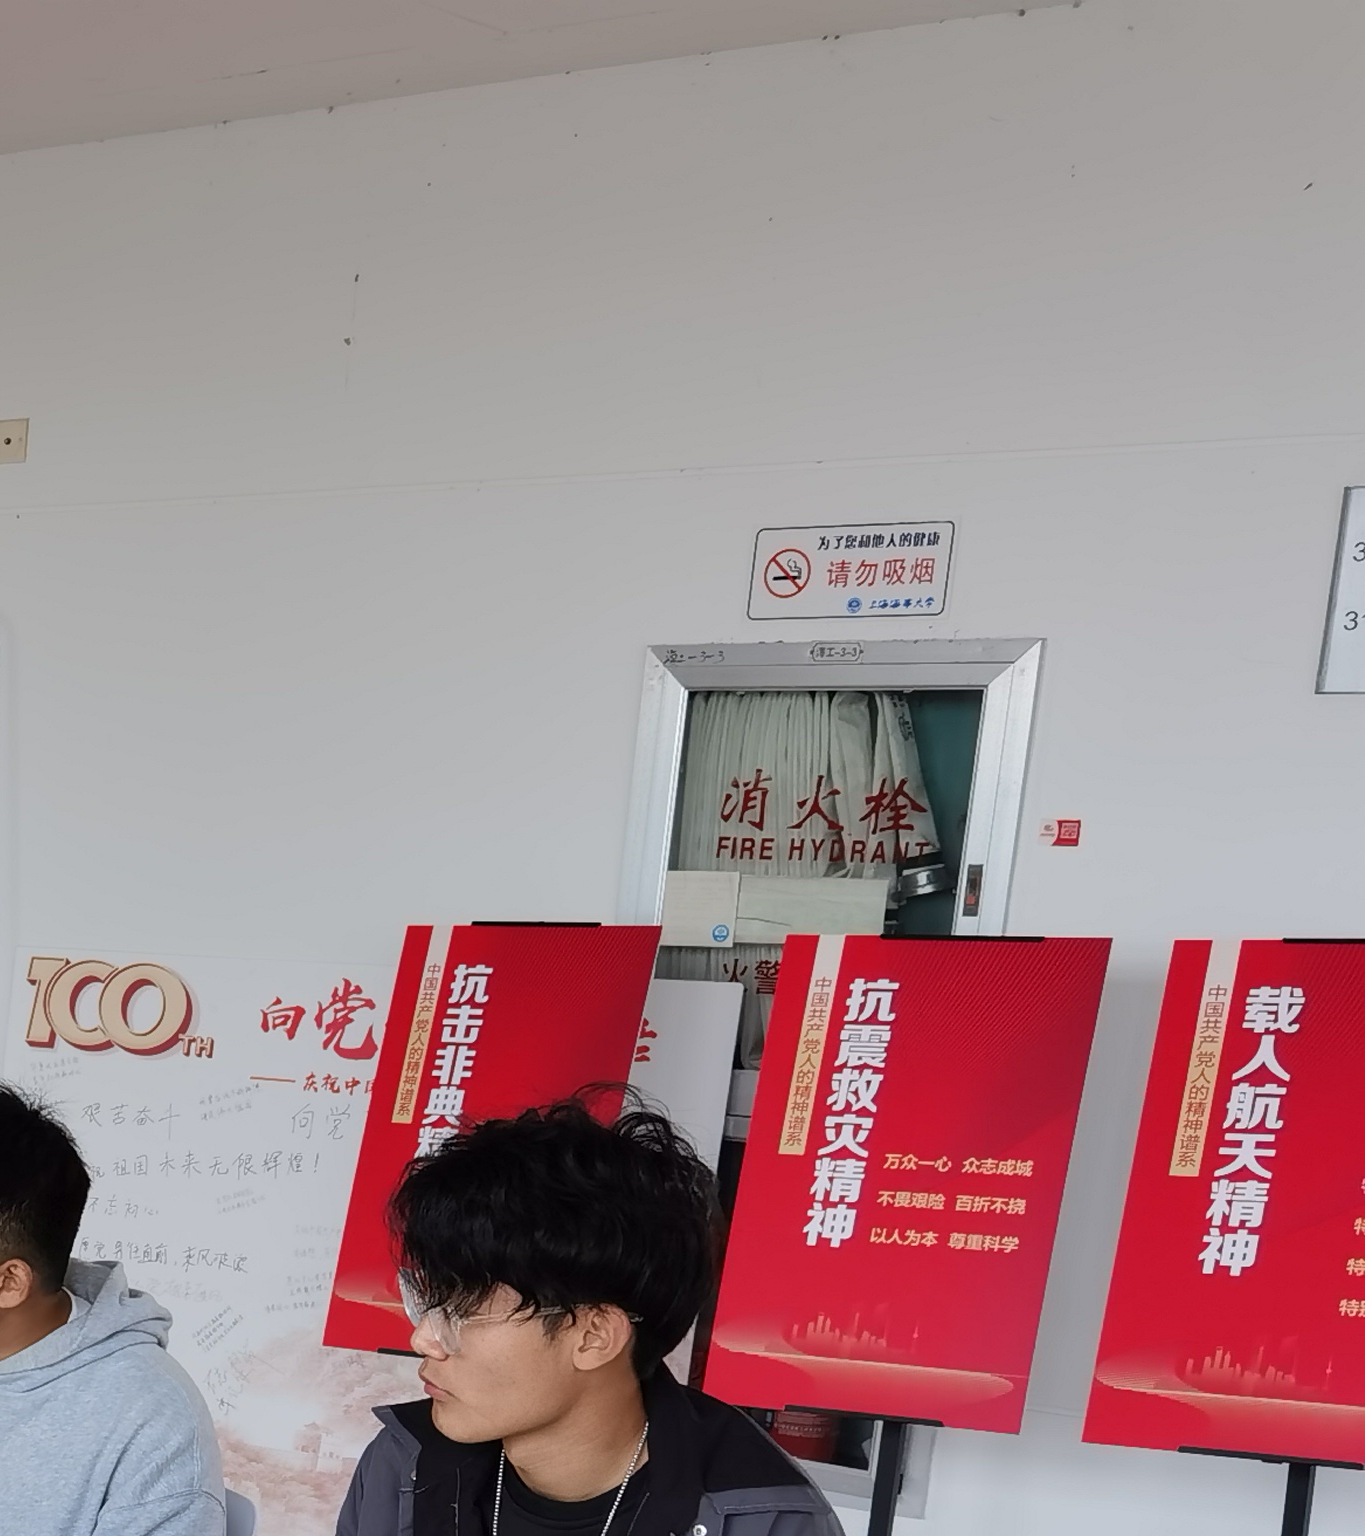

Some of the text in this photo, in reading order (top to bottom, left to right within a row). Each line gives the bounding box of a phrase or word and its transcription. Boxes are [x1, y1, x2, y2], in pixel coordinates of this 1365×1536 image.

[817, 531, 941, 551] 为了您和他人的健康
[826, 557, 936, 588] 请勿吸烟
[720, 769, 928, 835] 消火栓
[716, 836, 773, 860] FIRE
[397, 961, 442, 1118] 中国共产党人的精神谱系
[783, 975, 833, 1147] 中国共产党人的精神谱系
[1175, 983, 1229, 1169] 中国共产党人的精神谱系
[81, 1102, 181, 1141] 艰苦奋斗
[291, 1103, 352, 1140] 向党
[802, 977, 901, 1249] 抗震救灾精神
[1197, 985, 1307, 1278] 载人航天精神
[882, 1152, 1034, 1178] 万众一心 众志成城
[87, 1194, 160, 1219] 不忘初心
[876, 1190, 1027, 1216] 不畏艰险 百折不挠
[869, 1226, 1020, 1254] 以人为本 尊重科学
